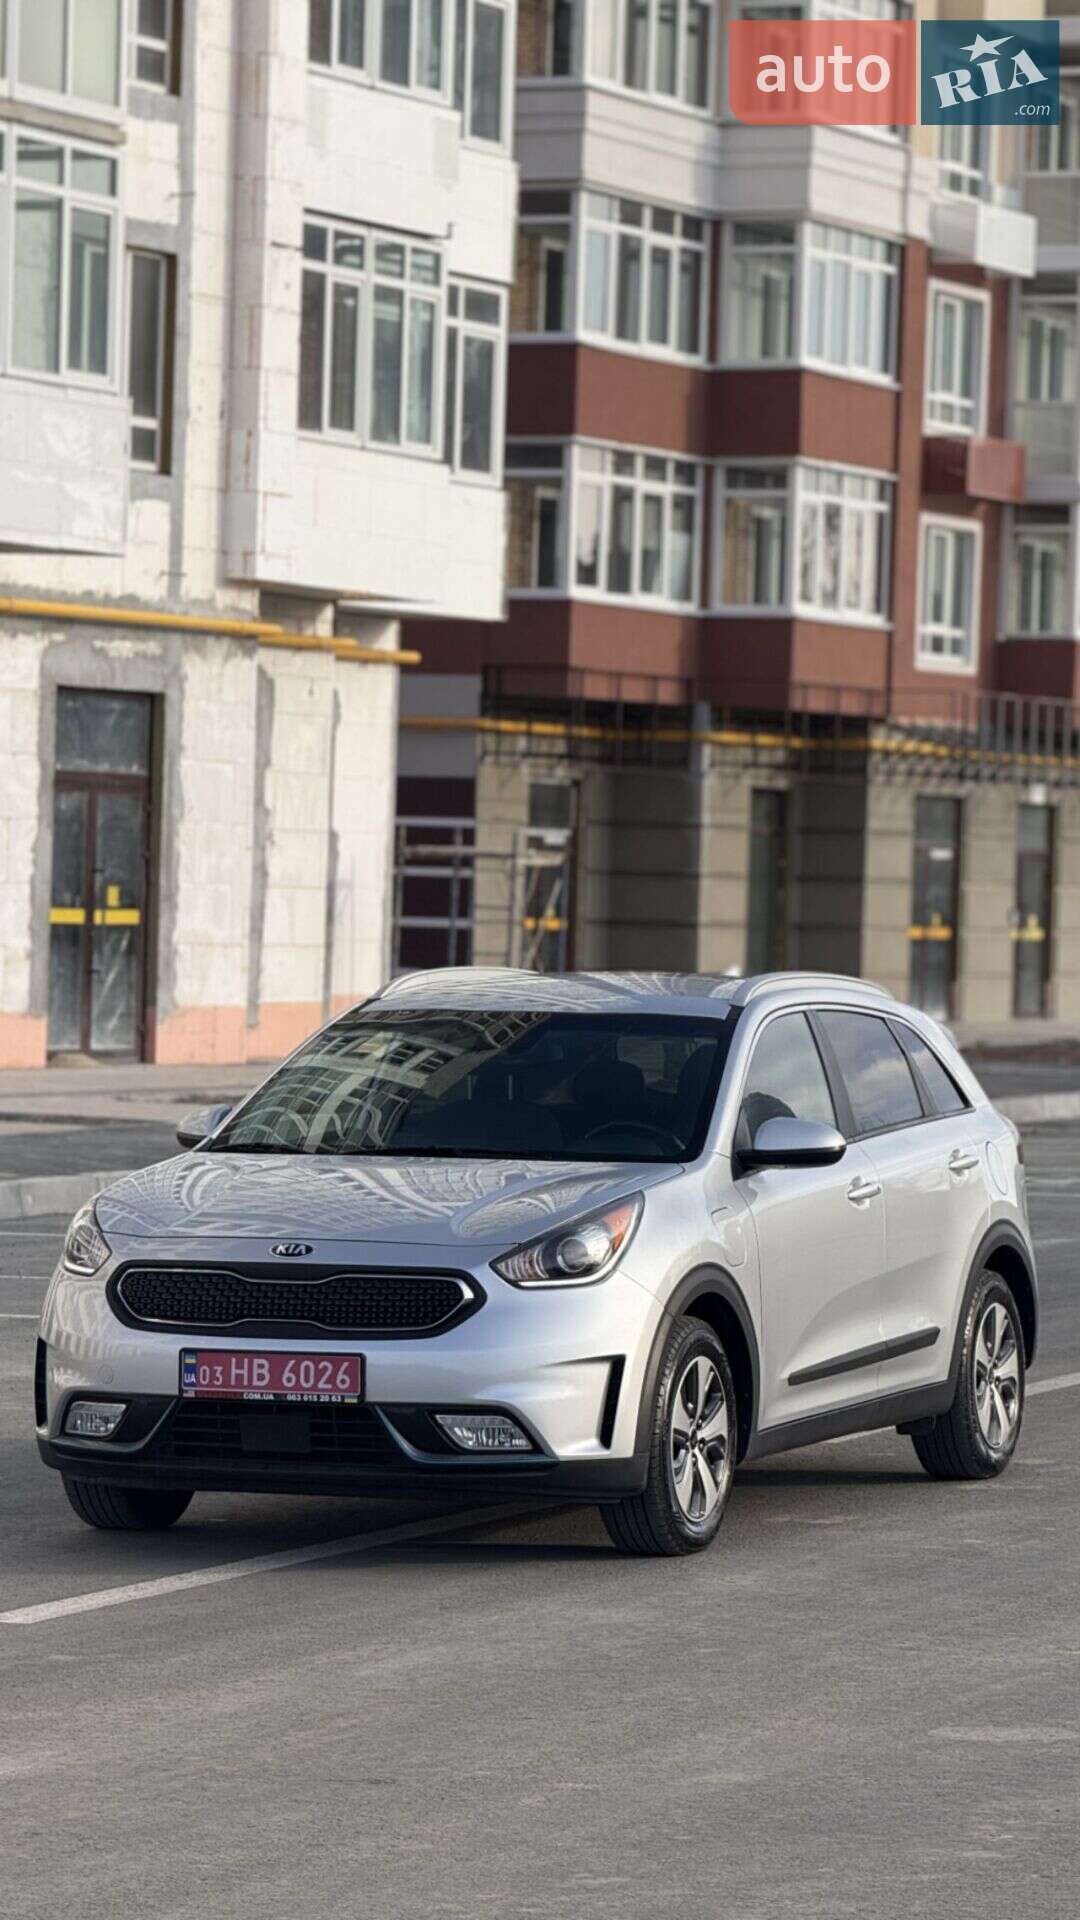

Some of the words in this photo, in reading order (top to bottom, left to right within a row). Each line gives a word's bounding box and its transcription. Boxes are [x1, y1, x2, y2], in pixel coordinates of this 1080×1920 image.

[184, 1373, 197, 1384] UA
[199, 1365, 224, 1385] 03
[230, 1357, 270, 1387] HB
[281, 1359, 351, 1390] 6026
[243, 1392, 275, 1400] COM.UA
